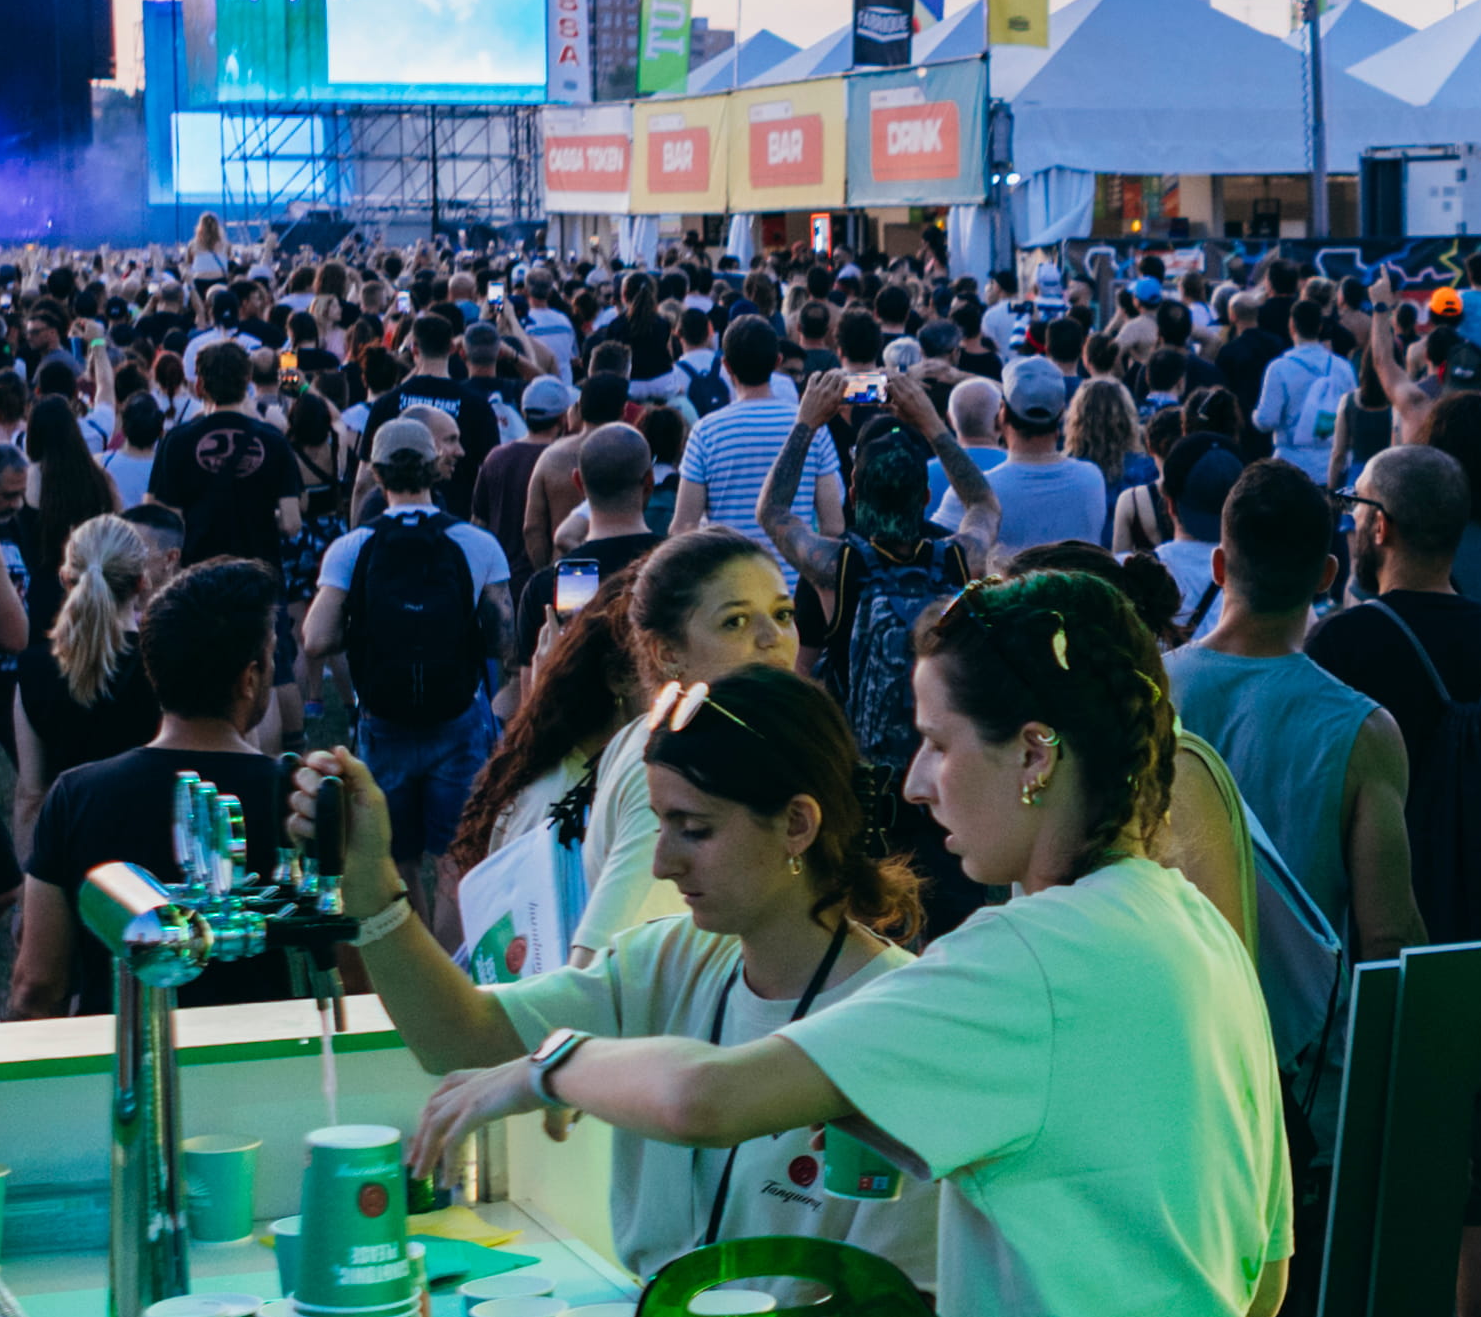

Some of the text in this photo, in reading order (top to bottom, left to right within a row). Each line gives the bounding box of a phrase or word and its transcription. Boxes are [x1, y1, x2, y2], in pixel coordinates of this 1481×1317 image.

[856, 9, 910, 36] FABRIQUE
[767, 129, 804, 165] BAR
[887, 117, 943, 157] DRINK
[661, 140, 694, 174] BAR
